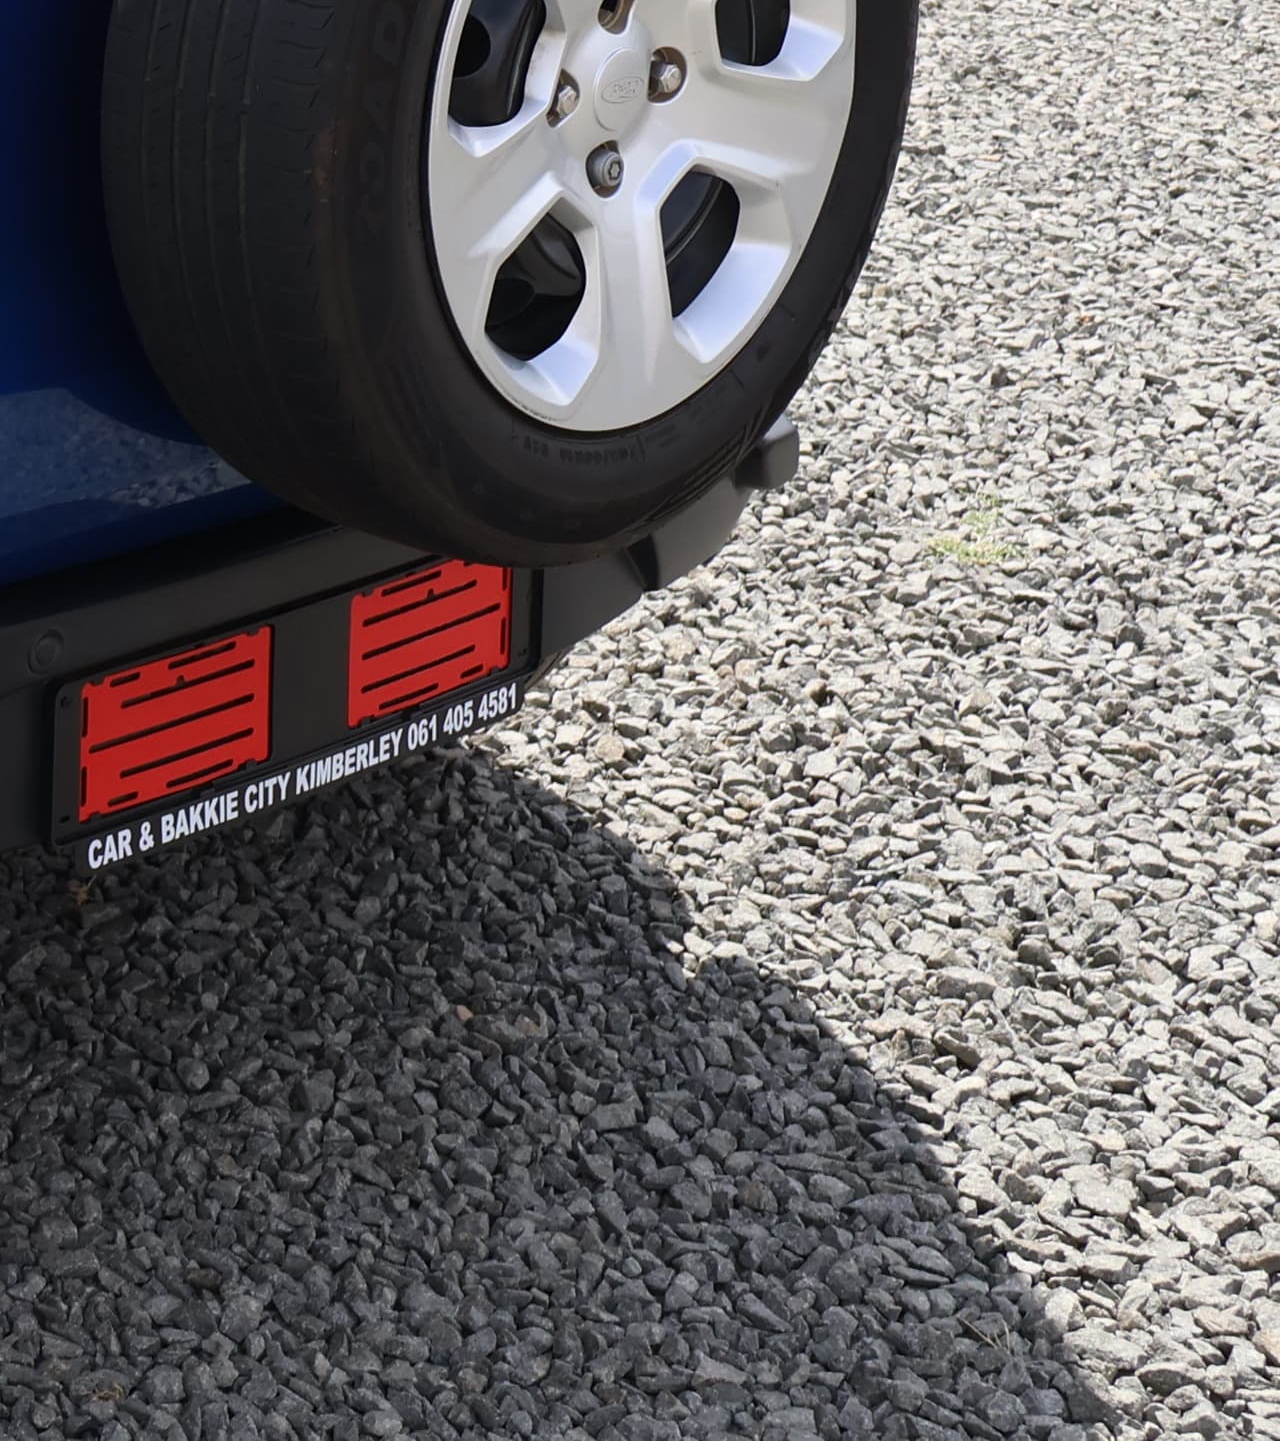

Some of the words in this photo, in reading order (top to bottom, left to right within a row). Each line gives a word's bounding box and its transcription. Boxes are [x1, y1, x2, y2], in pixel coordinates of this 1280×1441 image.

[88, 828, 133, 870] CAR
[138, 821, 155, 852] &
[161, 790, 240, 844] BAKKIE
[244, 771, 291, 814] CITY
[295, 728, 404, 796] KIMBERLEY
[407, 714, 438, 751] 061
[443, 699, 474, 735] 405
[478, 682, 517, 722] 4581
